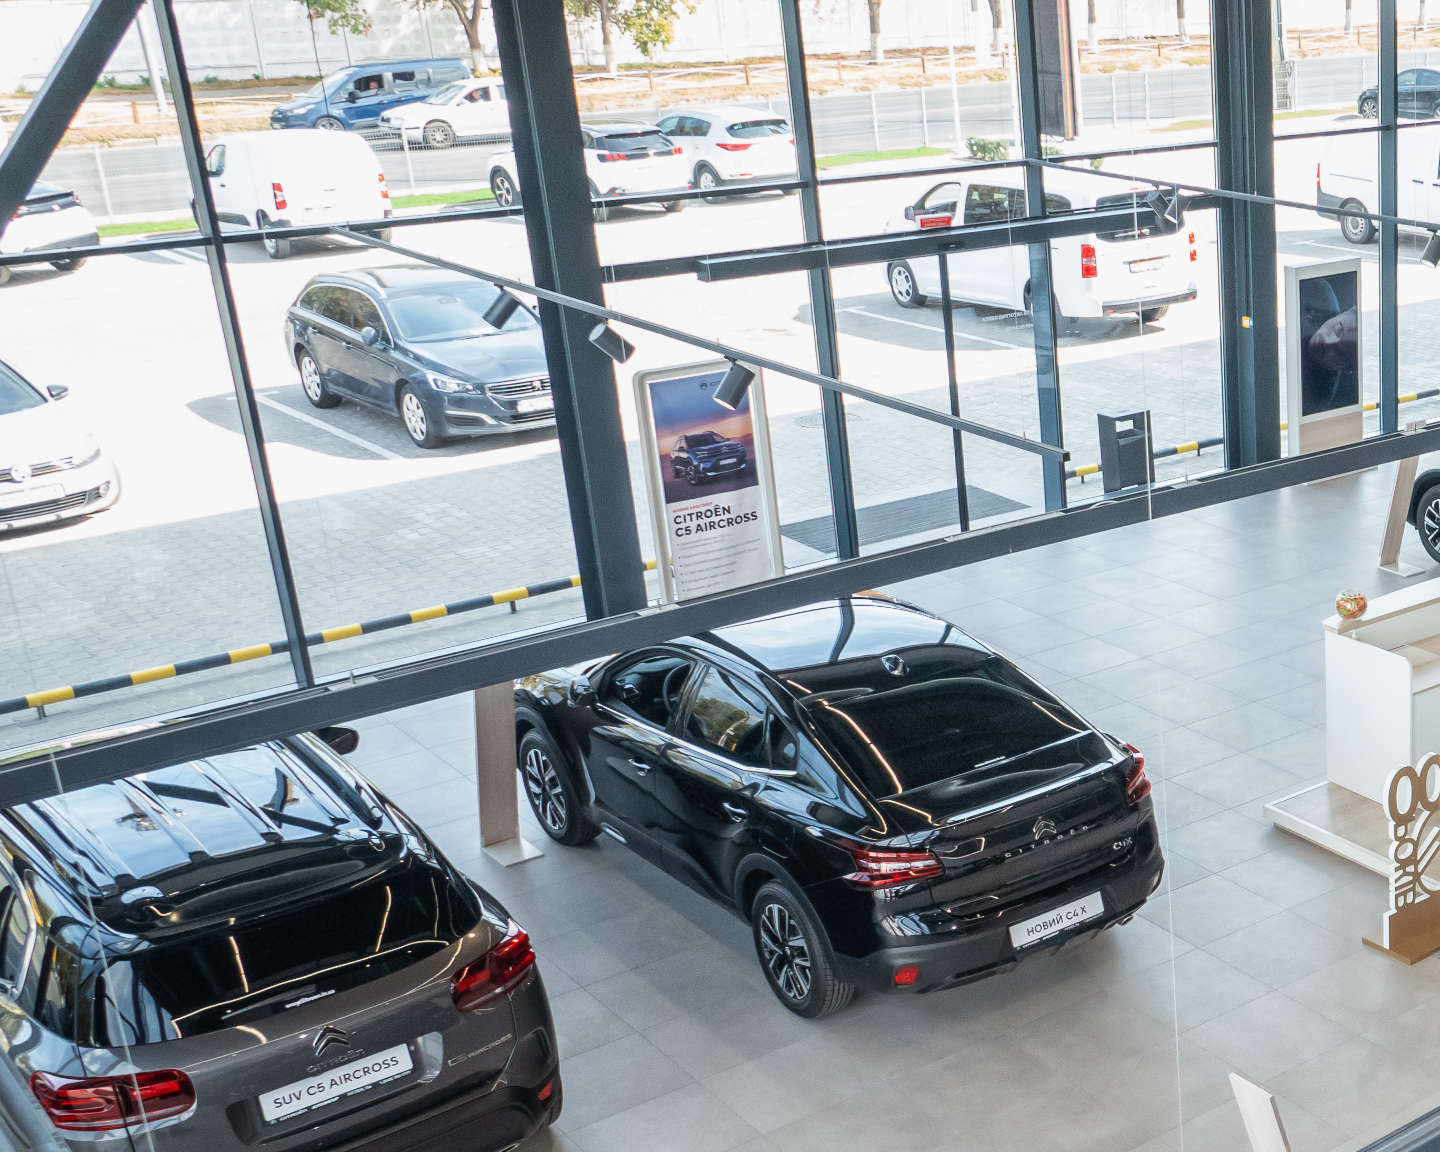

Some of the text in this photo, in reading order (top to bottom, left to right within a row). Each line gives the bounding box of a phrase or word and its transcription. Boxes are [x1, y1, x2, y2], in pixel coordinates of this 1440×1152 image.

[673, 504, 731, 525] CITROËN
[675, 511, 758, 537] C5 AIRCROSS
[1026, 912, 1063, 936] НОВИЙ
[1065, 910, 1079, 920] C4
[1080, 904, 1088, 916] X
[273, 1090, 302, 1109] SUV
[306, 1083, 325, 1097] C5
[329, 1056, 399, 1089] AIRCROSS
